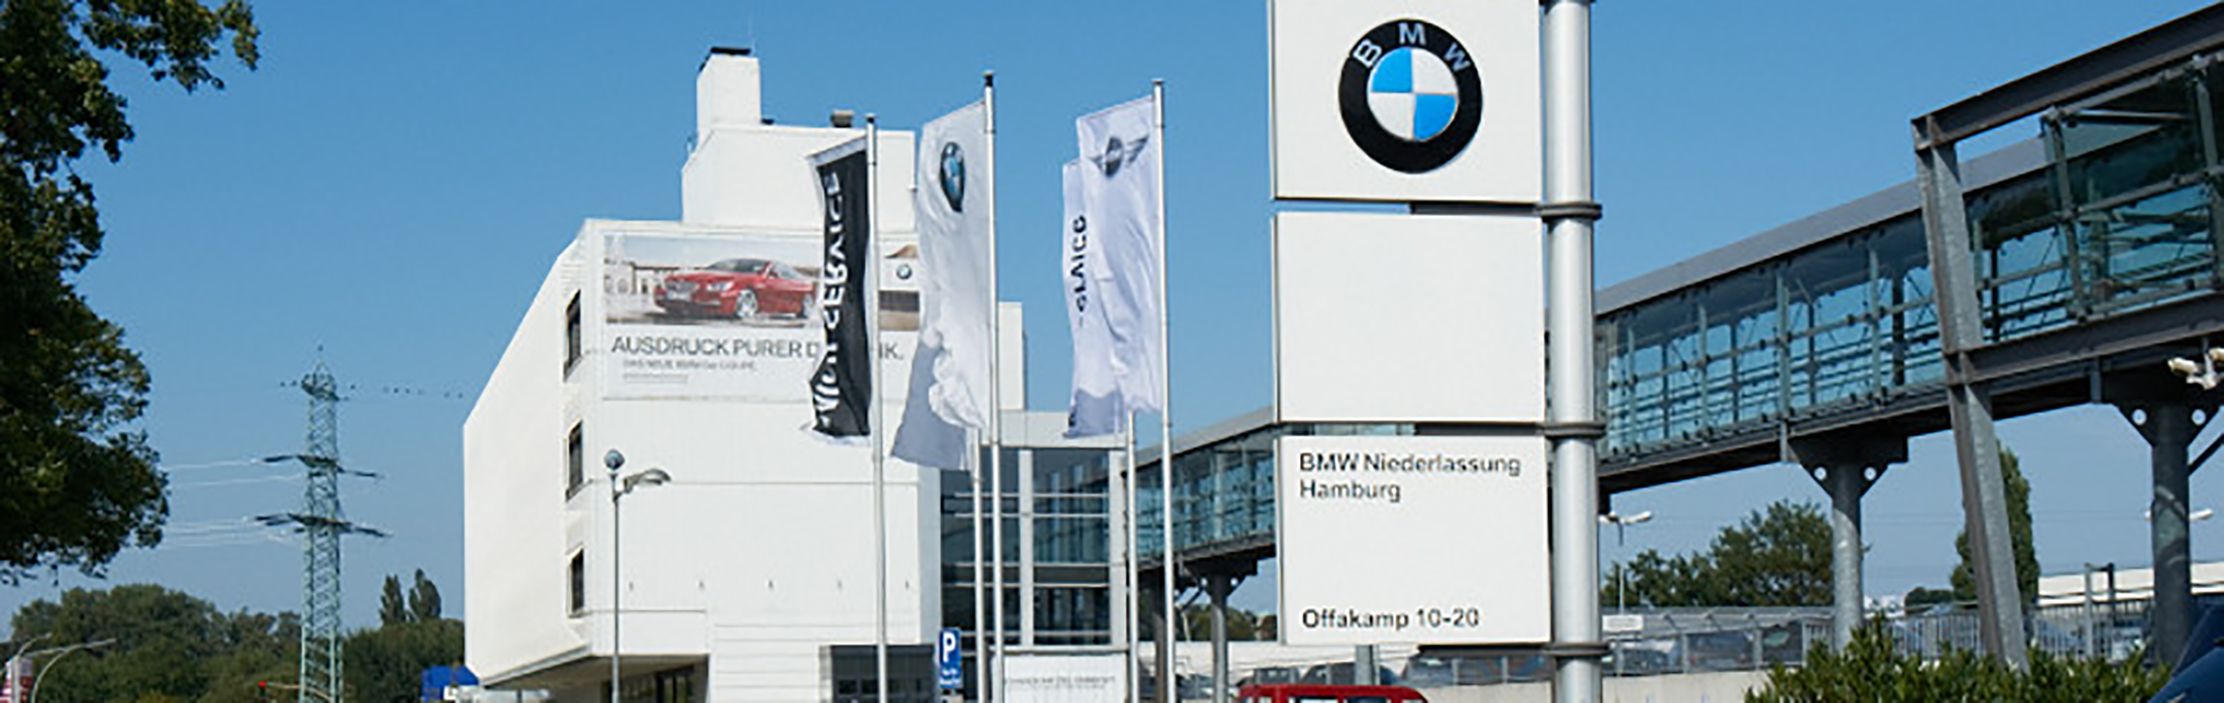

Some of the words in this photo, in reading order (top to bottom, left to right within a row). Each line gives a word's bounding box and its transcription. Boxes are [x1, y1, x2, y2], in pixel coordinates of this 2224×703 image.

[1353, 22, 1471, 72] BMW
[611, 336, 730, 356] AUSDRUCK
[733, 339, 803, 358] PURER
[1300, 453, 1361, 473] BMW
[1363, 452, 1522, 477] Niederlassung
[1300, 480, 1401, 503] Hamburg
[1302, 609, 1410, 631] Offakamp
[1416, 608, 1480, 628] 10-20
[943, 631, 956, 663] P
